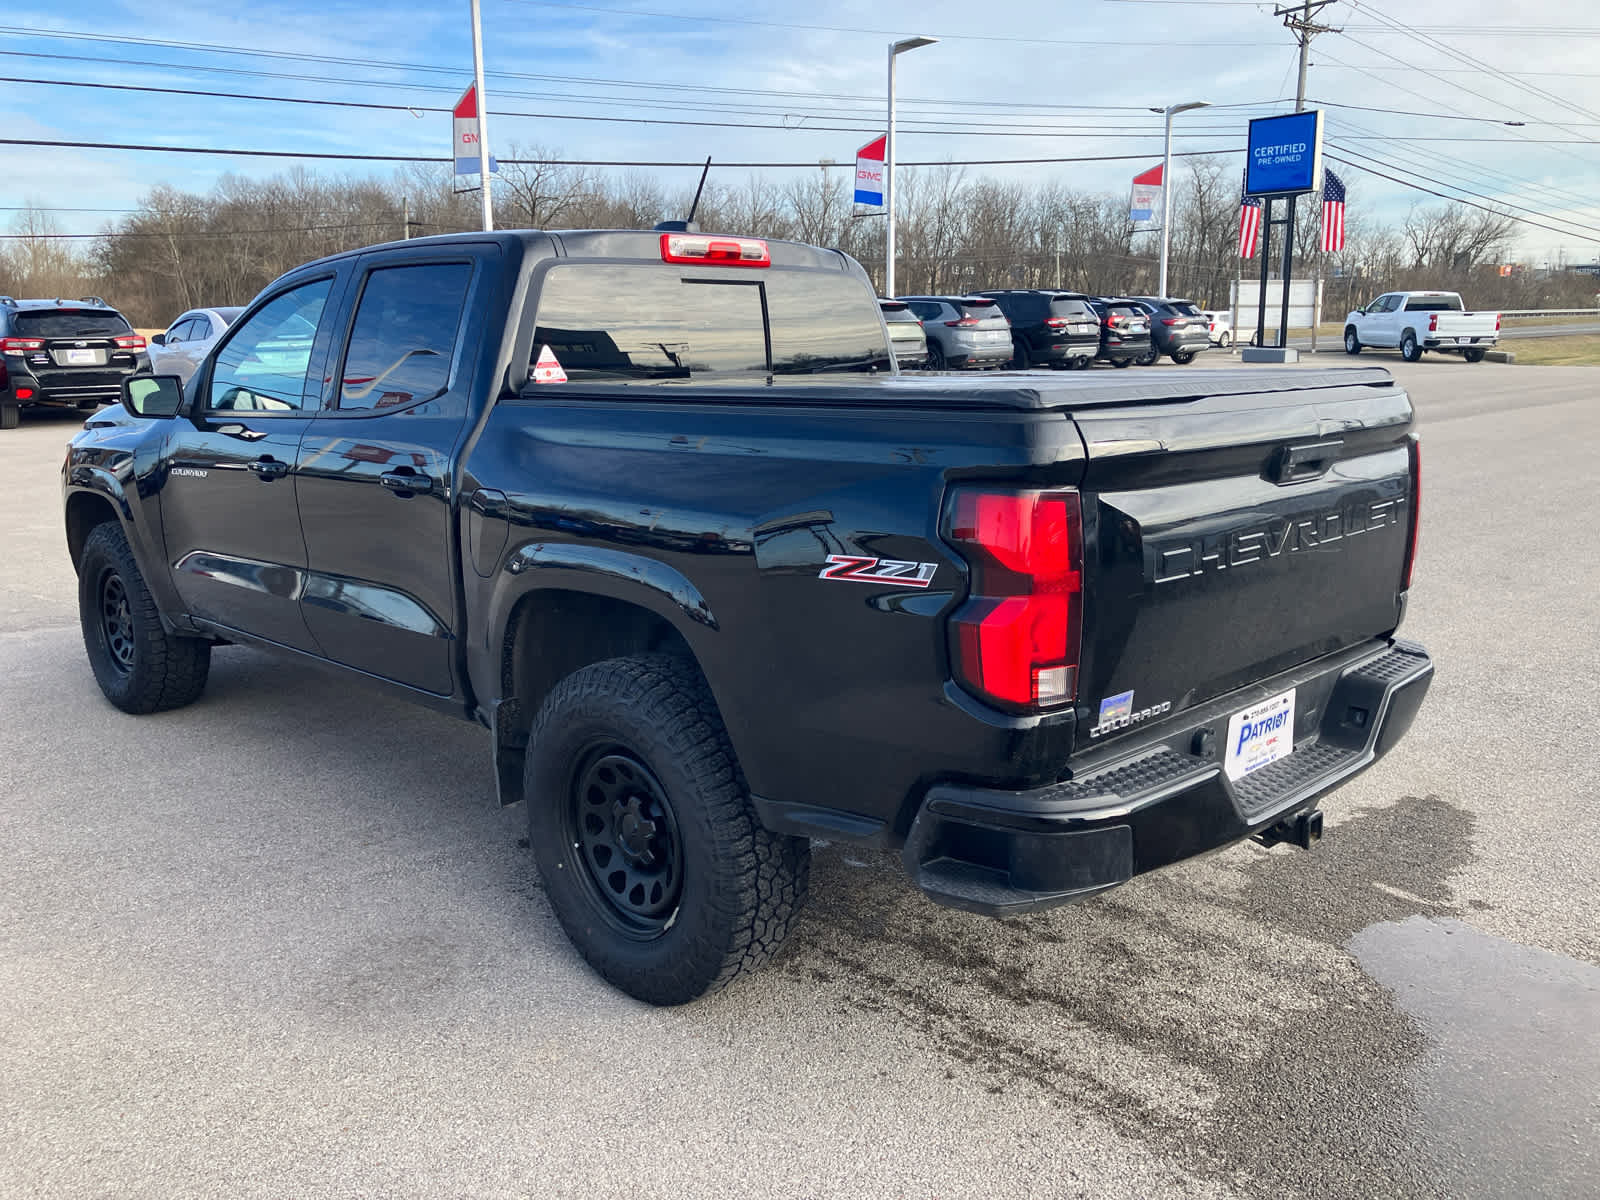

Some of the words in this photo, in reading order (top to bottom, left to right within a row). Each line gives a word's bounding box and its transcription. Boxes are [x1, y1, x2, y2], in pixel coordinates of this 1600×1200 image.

[1254, 142, 1307, 157] CERTIFIED
[1257, 154, 1302, 166] PRE-OWNED
[857, 169, 882, 182] GMC
[1153, 497, 1405, 584] CHEVROLET
[818, 553, 939, 588] Z71
[1089, 700, 1172, 739] COLORADO
